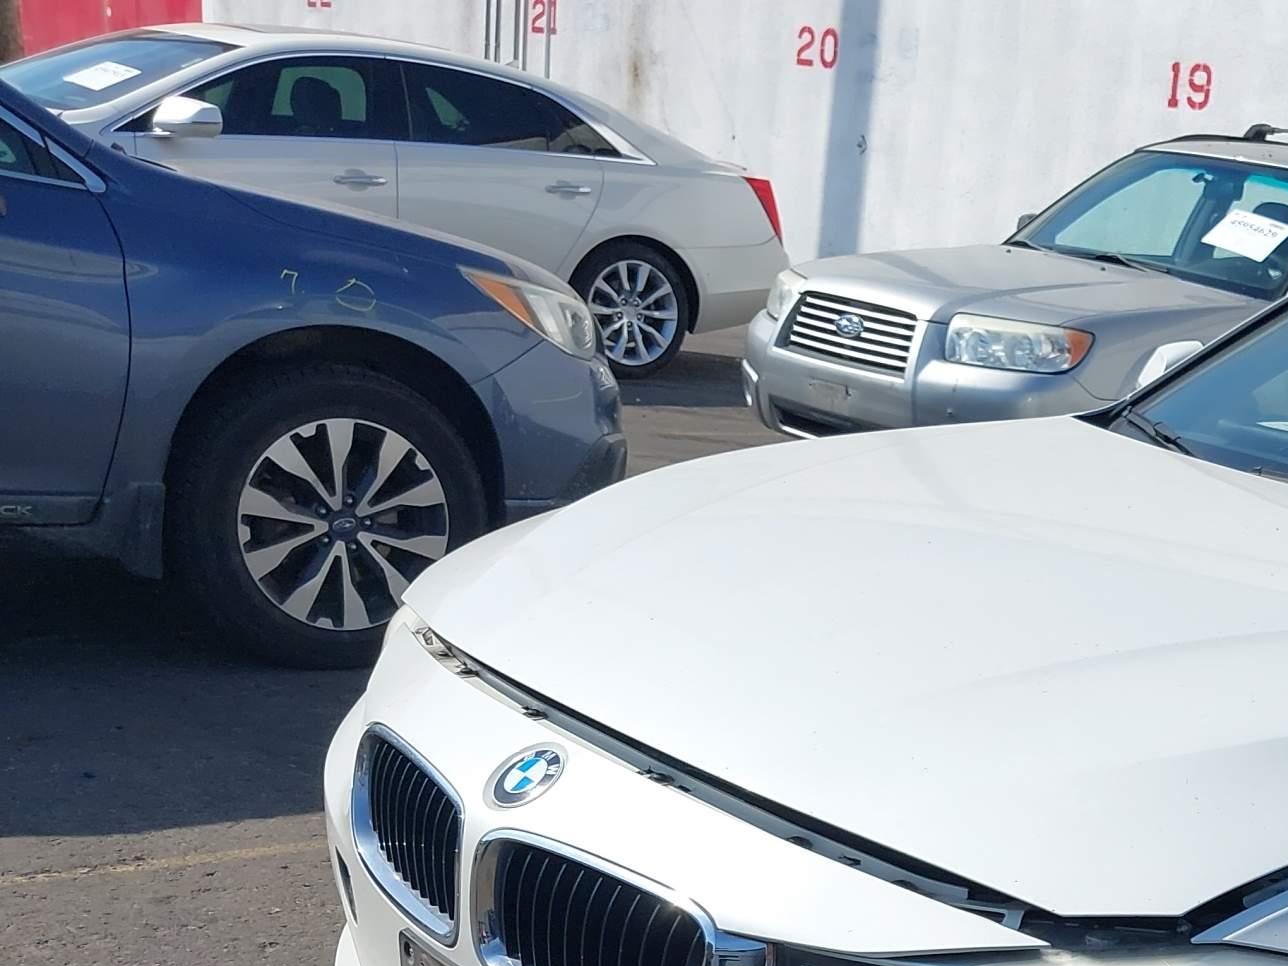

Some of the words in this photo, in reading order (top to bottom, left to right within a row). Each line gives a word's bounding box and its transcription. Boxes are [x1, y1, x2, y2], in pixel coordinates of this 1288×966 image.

[531, 0, 557, 35] 21
[797, 26, 839, 69] 20
[1168, 61, 1212, 111] 19
